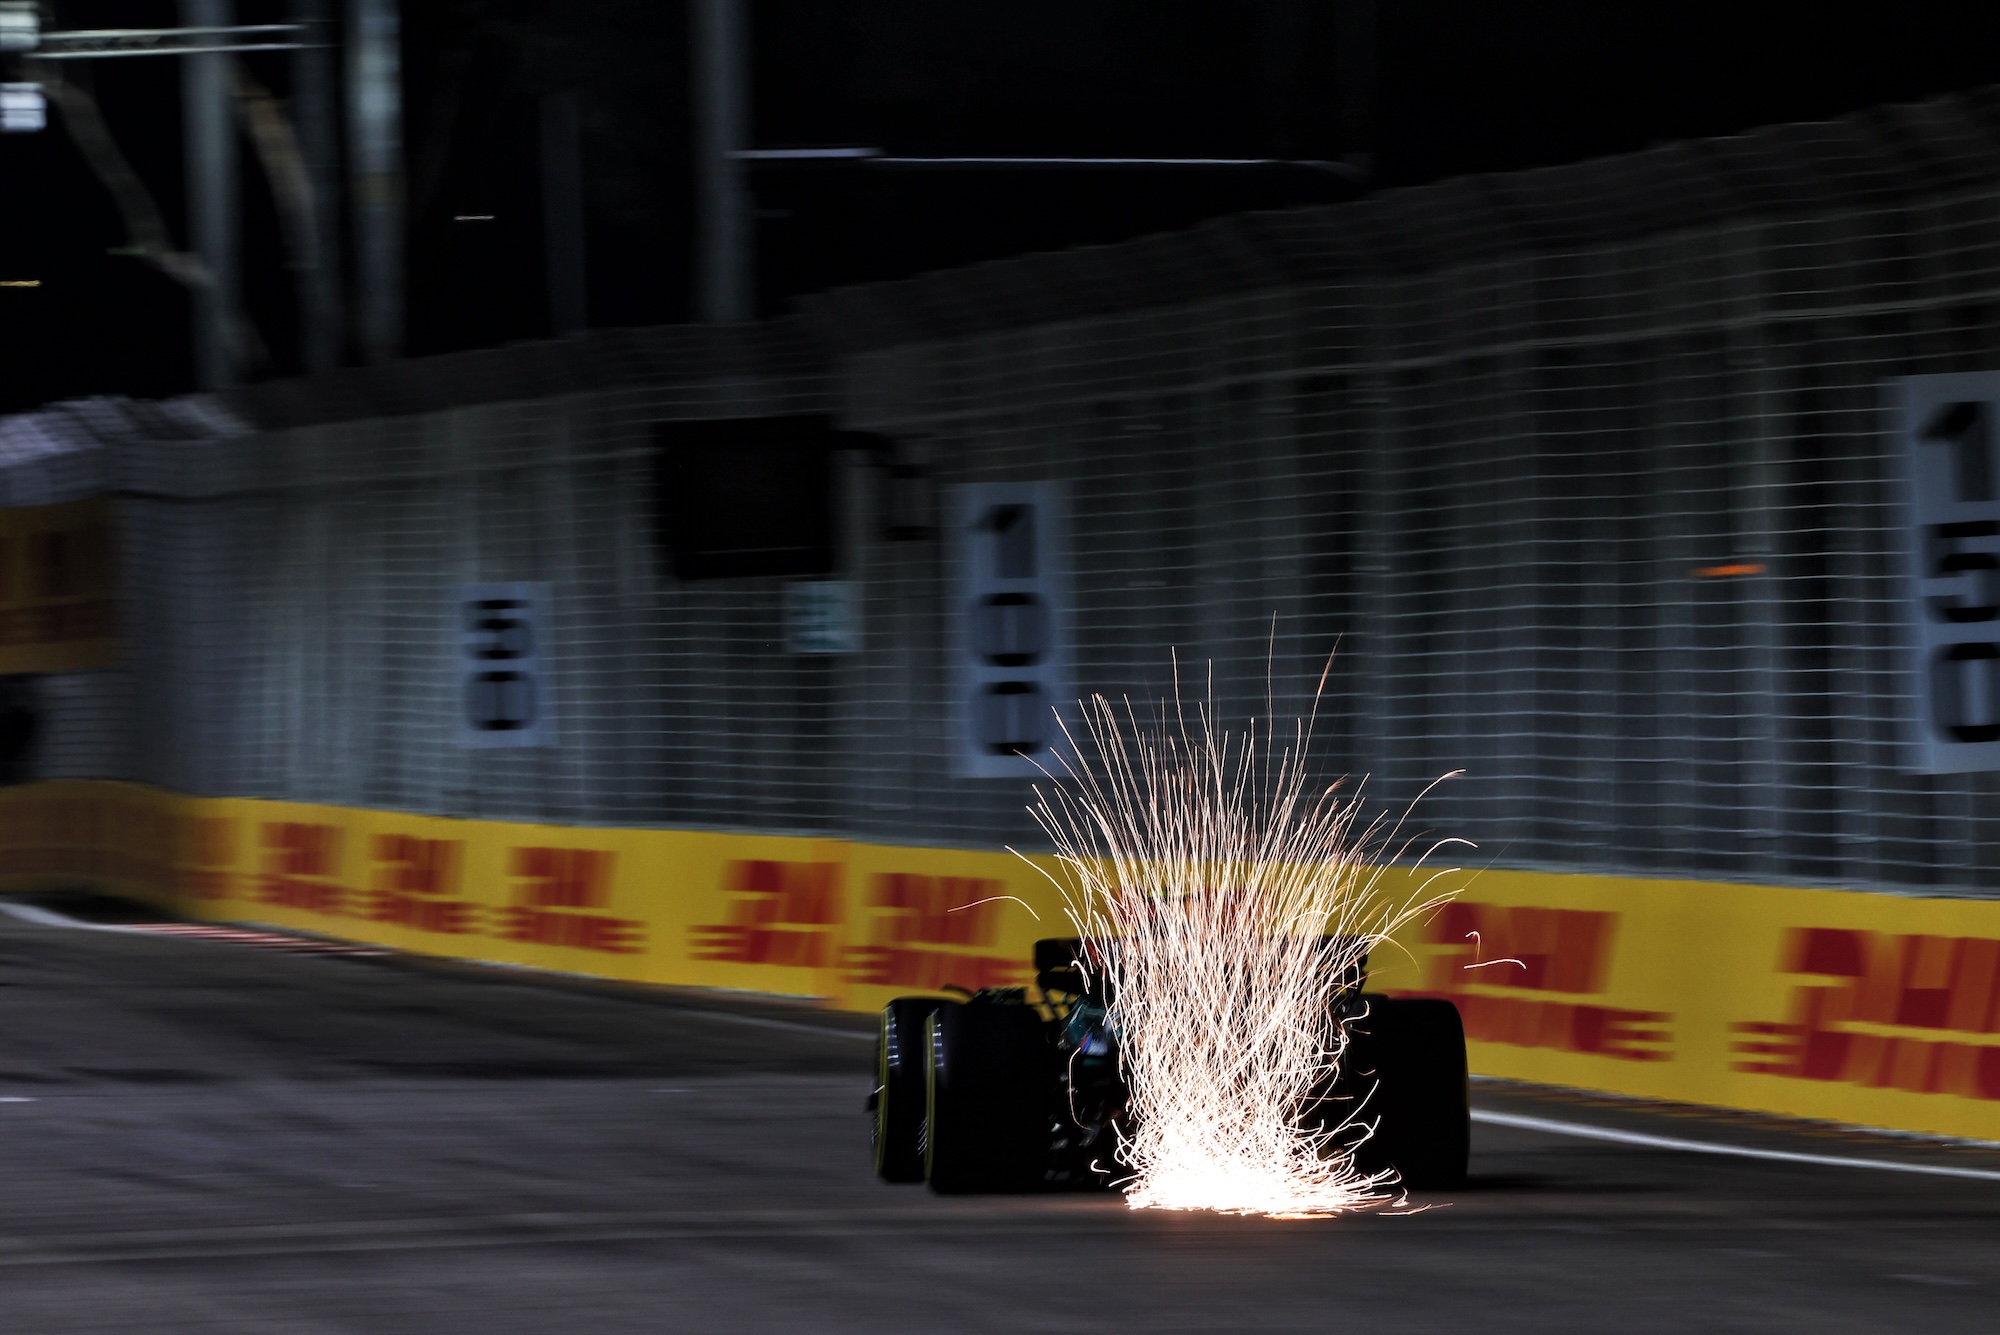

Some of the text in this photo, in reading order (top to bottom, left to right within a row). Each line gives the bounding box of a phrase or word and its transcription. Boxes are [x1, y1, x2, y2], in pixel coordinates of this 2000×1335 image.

[465, 600, 538, 730] 50
[973, 503, 1050, 756] 100
[1918, 402, 2000, 743] 150
